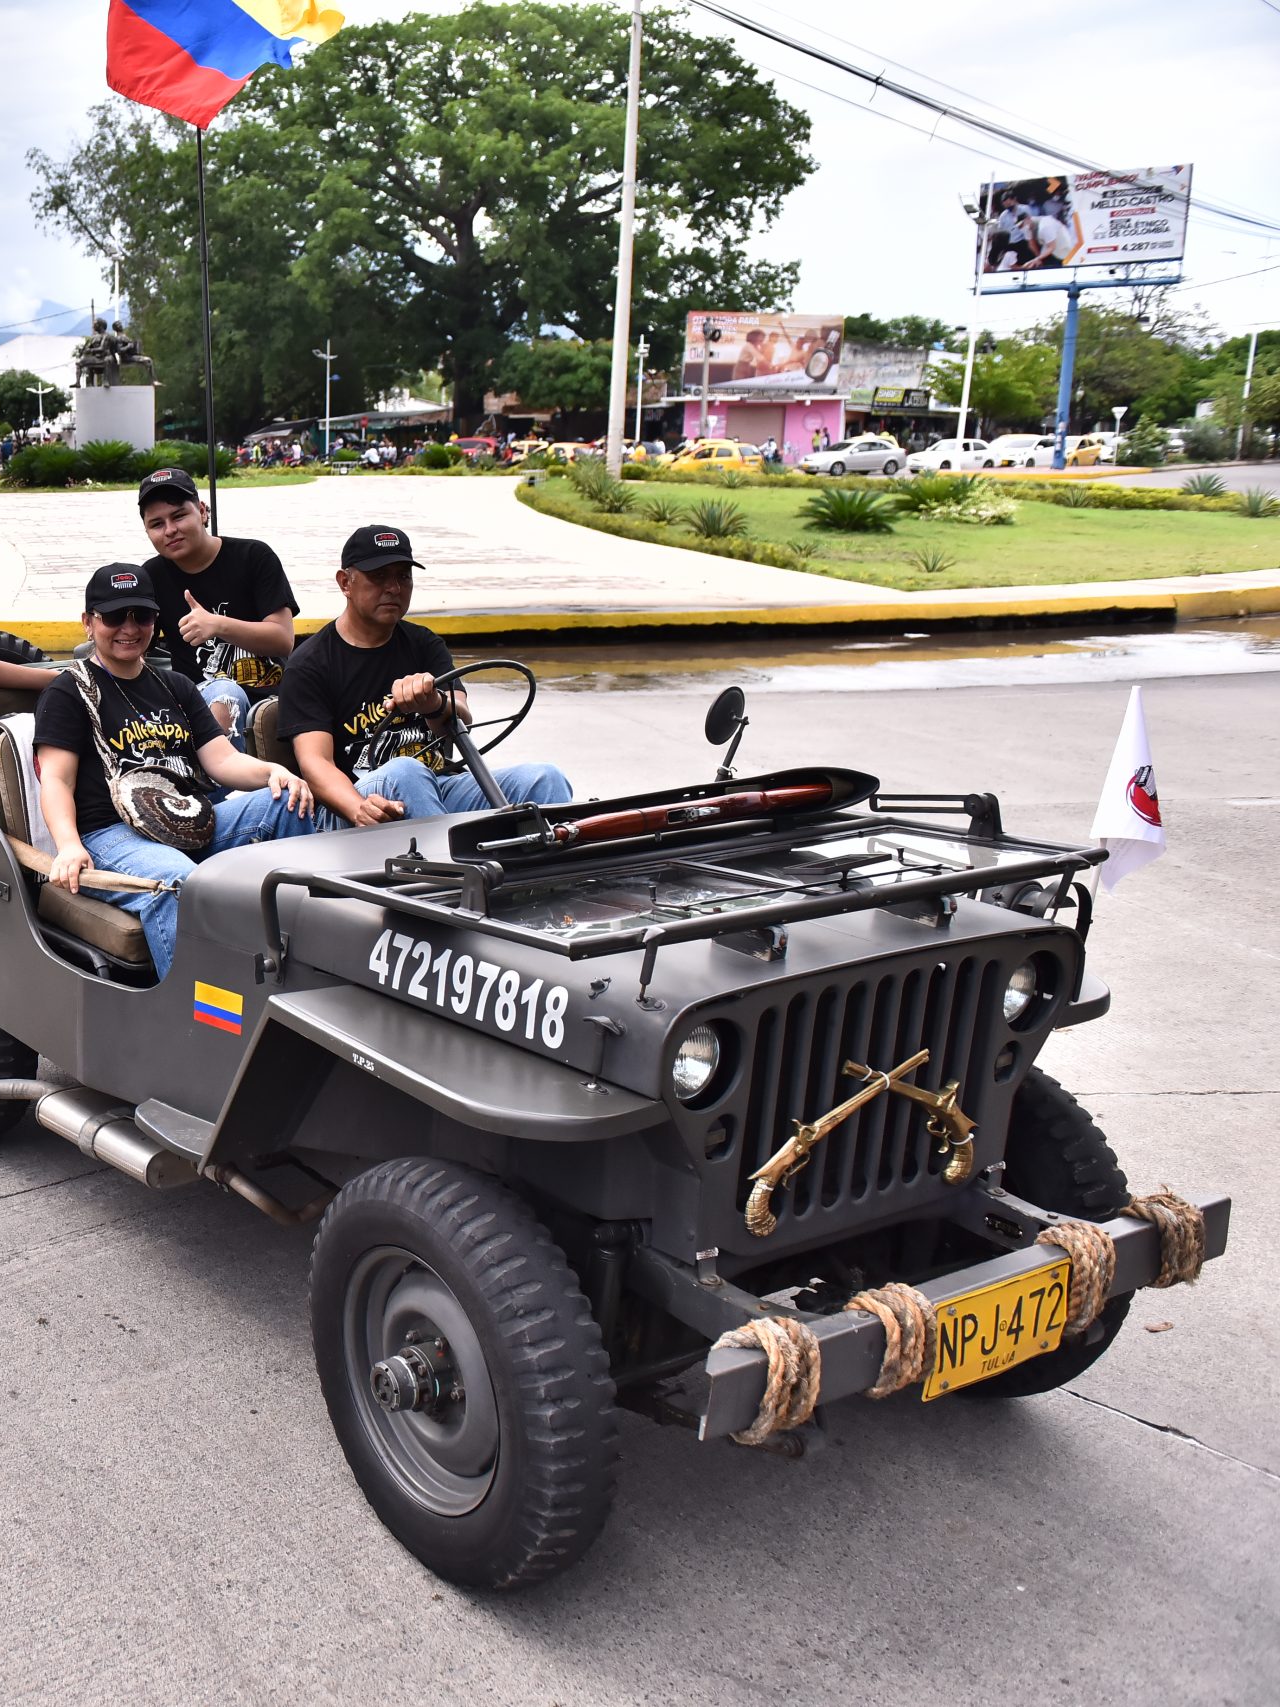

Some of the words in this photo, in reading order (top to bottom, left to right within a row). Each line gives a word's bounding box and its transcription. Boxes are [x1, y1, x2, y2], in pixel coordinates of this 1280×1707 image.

[1091, 198, 1128, 209] MELLO
[1129, 193, 1175, 206] CASTRO
[1122, 226, 1171, 237] COLOMBIA
[368, 928, 570, 1051] 472197818
[937, 1303, 1000, 1375] NPJ
[1006, 1281, 1064, 1346] 472
